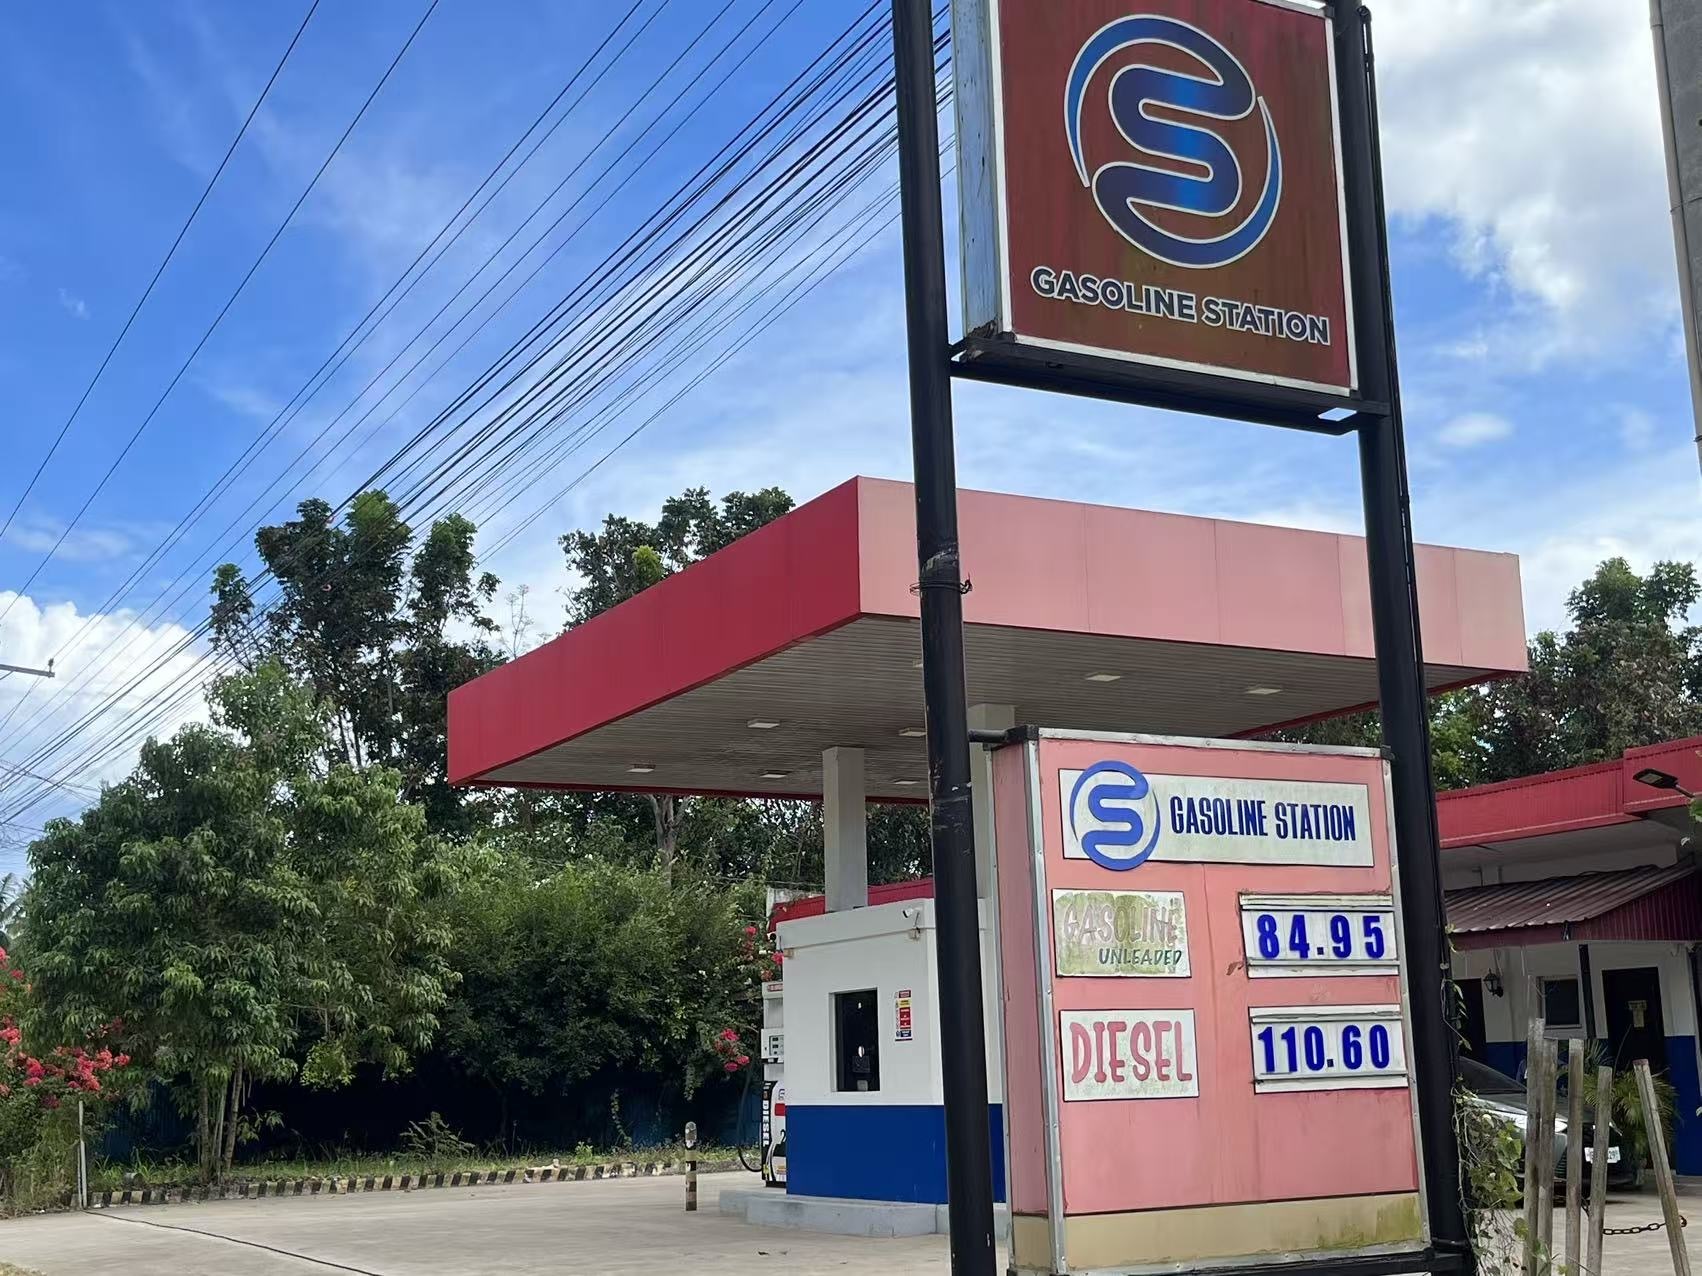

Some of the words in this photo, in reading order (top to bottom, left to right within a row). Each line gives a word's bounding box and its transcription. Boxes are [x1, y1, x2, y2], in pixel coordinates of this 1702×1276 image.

[1030, 266, 1198, 323] GASOLINE
[1200, 297, 1331, 345] STATION
[1170, 796, 1268, 838] GASOLINE
[1275, 802, 1356, 841] STATION
[1063, 902, 1178, 945] GASOLINE
[1256, 914, 1385, 959] 84.95
[1098, 947, 1183, 966] UNLEADED
[1069, 1020, 1193, 1084] DIESEL
[1257, 1024, 1391, 1074] 110.60
[762, 1100, 771, 1147] DIESEL
